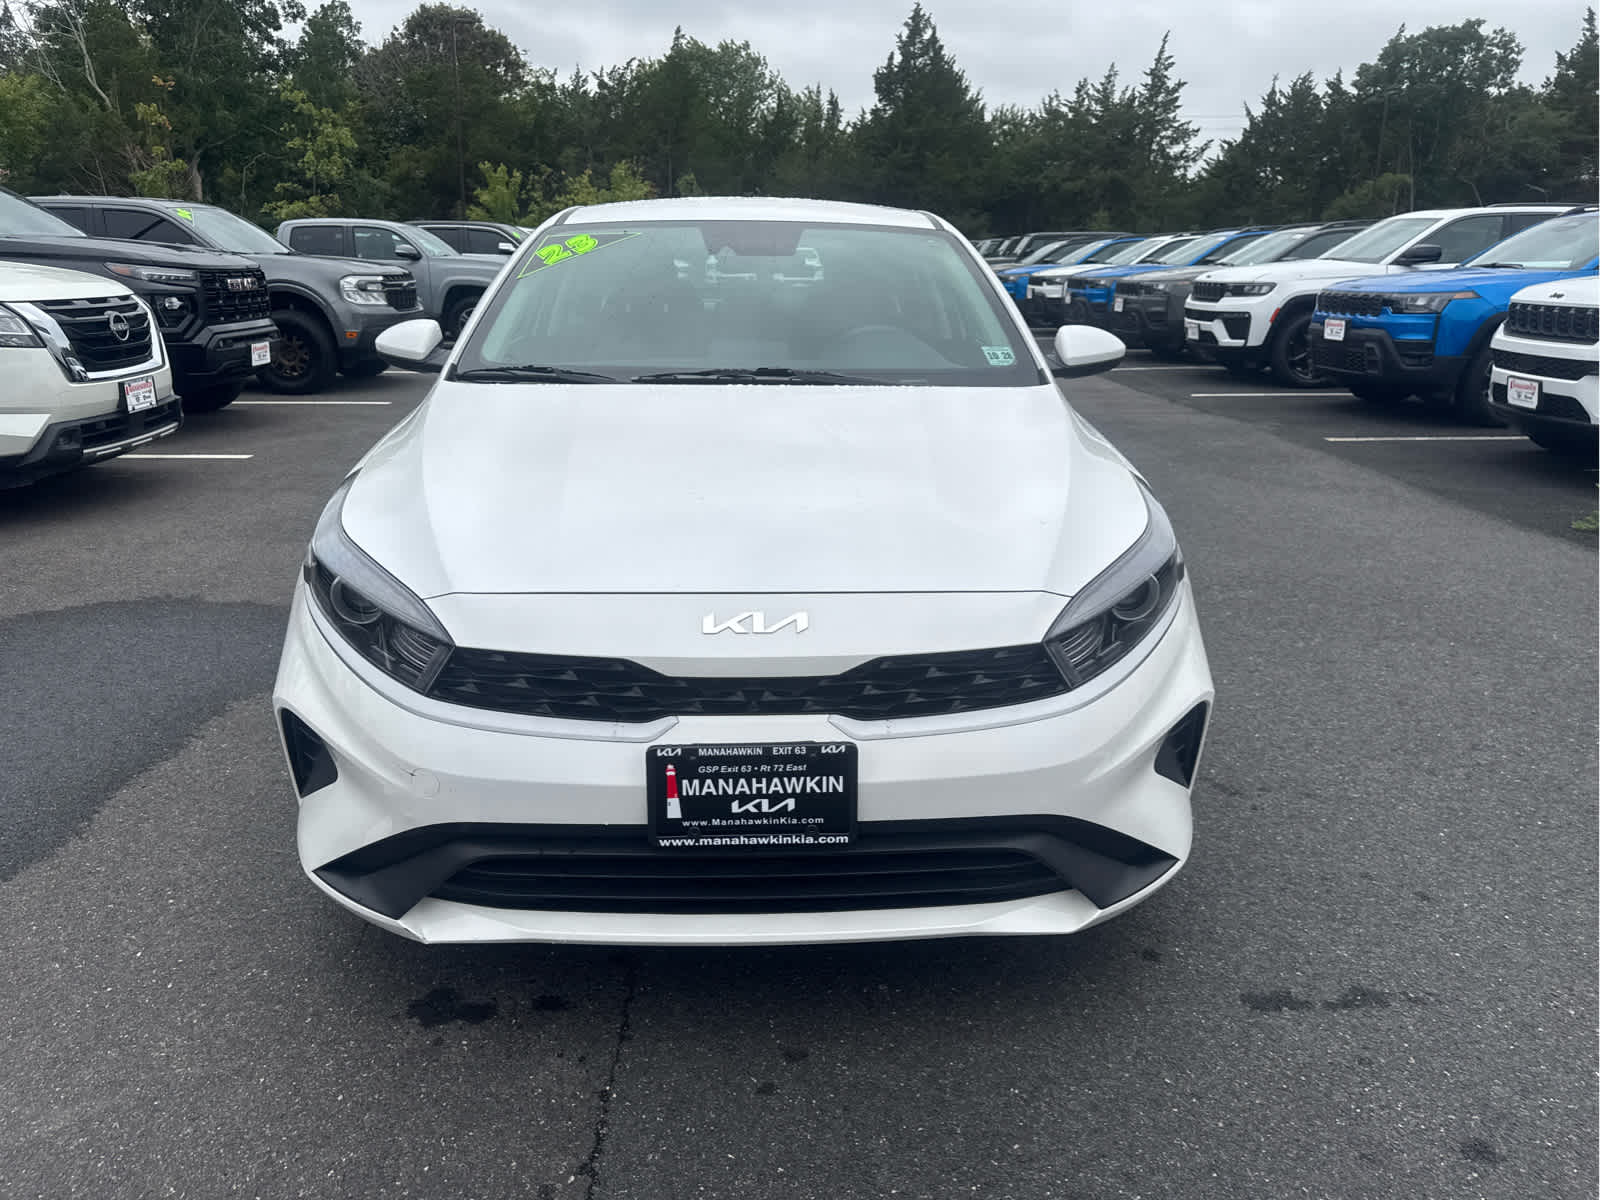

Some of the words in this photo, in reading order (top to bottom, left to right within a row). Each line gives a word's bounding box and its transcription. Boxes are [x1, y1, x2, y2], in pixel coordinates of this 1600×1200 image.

[536, 234, 598, 265] 23
[702, 611, 808, 634] KIA
[657, 747, 682, 757] KIA
[698, 748, 763, 756] MANAHAWKIN
[772, 747, 792, 755] EXIT
[794, 747, 807, 755] 63
[821, 745, 846, 754] KIA
[773, 764, 784, 772] 72
[682, 776, 844, 796] MANAHAWKIN
[731, 798, 796, 813] KIA
[682, 817, 824, 826] www.ManahawkinKia.com
[659, 834, 849, 847] www.manahawkinkia.com
